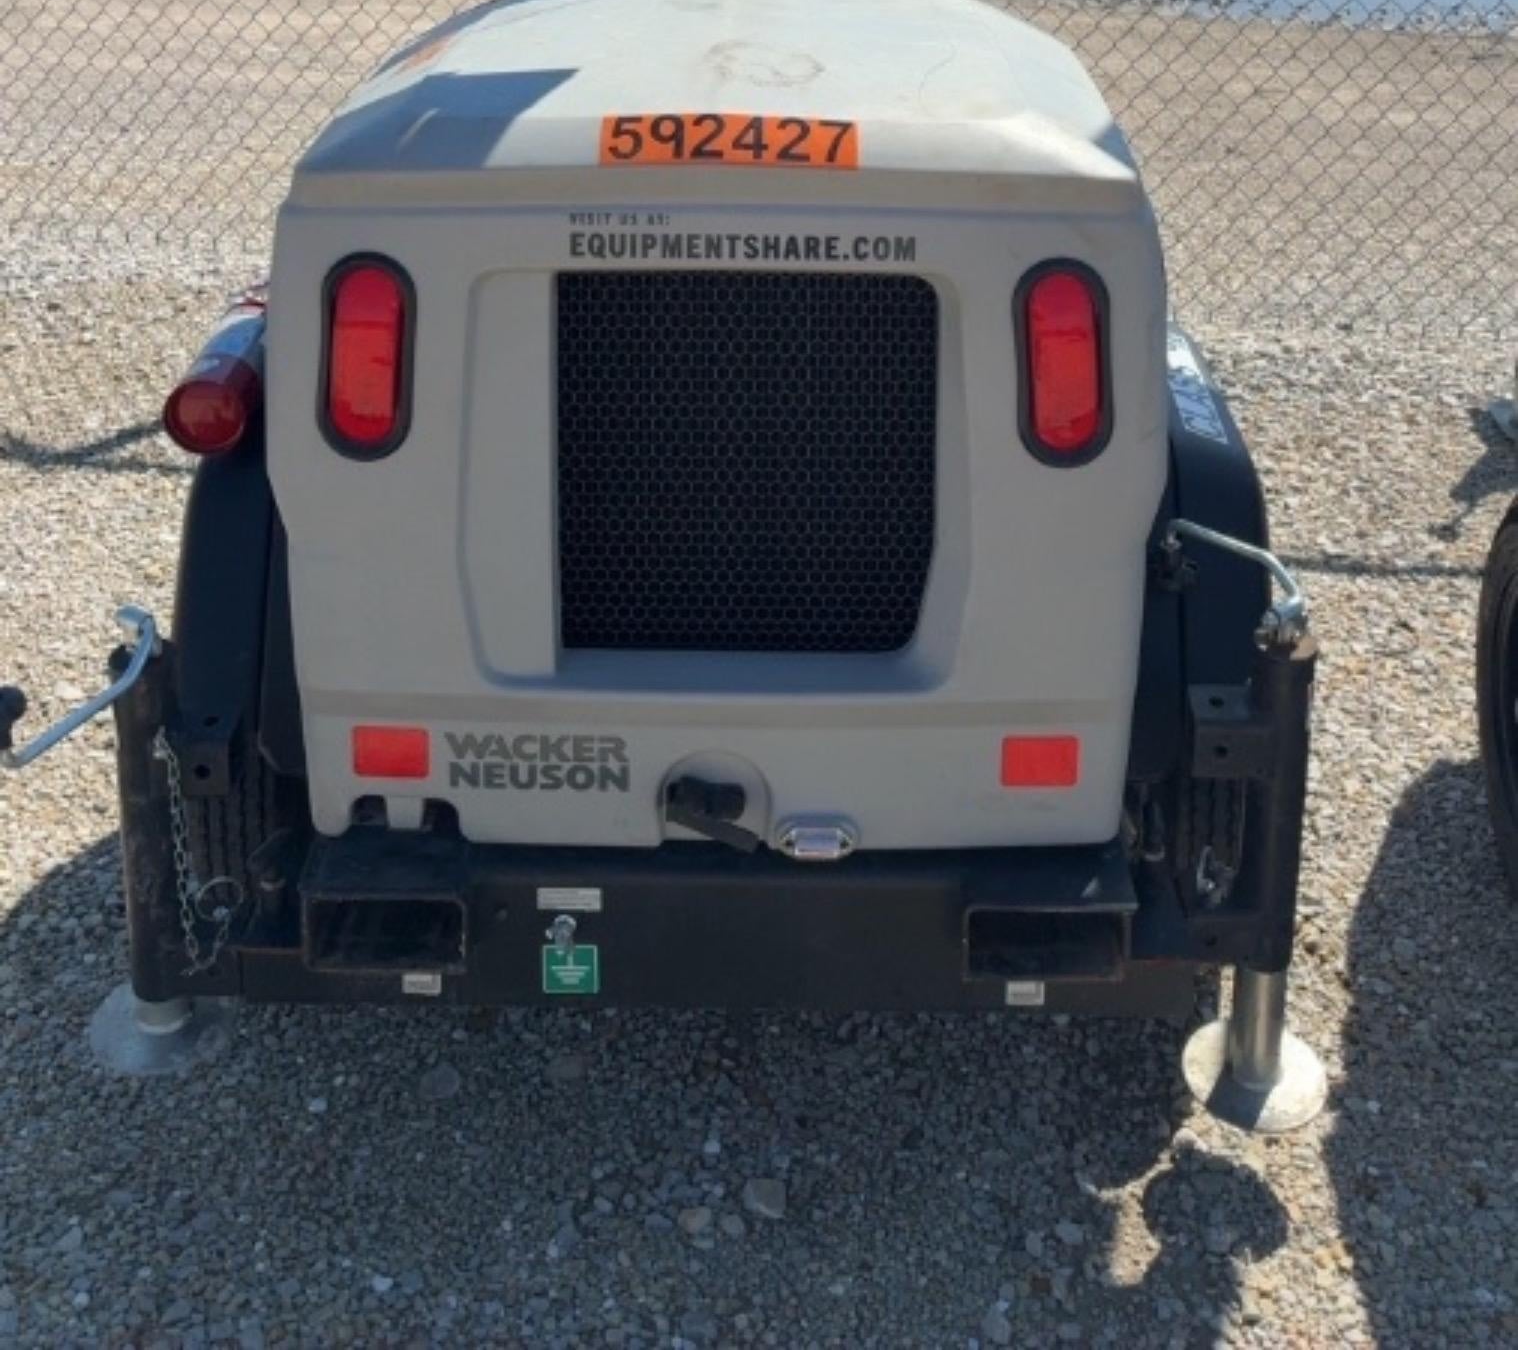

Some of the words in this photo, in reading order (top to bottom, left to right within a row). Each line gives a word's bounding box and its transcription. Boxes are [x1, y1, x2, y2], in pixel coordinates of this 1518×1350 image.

[607, 114, 853, 163] 592427
[569, 233, 916, 262] EQUIPMENTSHARE.COM
[444, 731, 629, 763] WACKER
[450, 761, 630, 792] NEUSON
